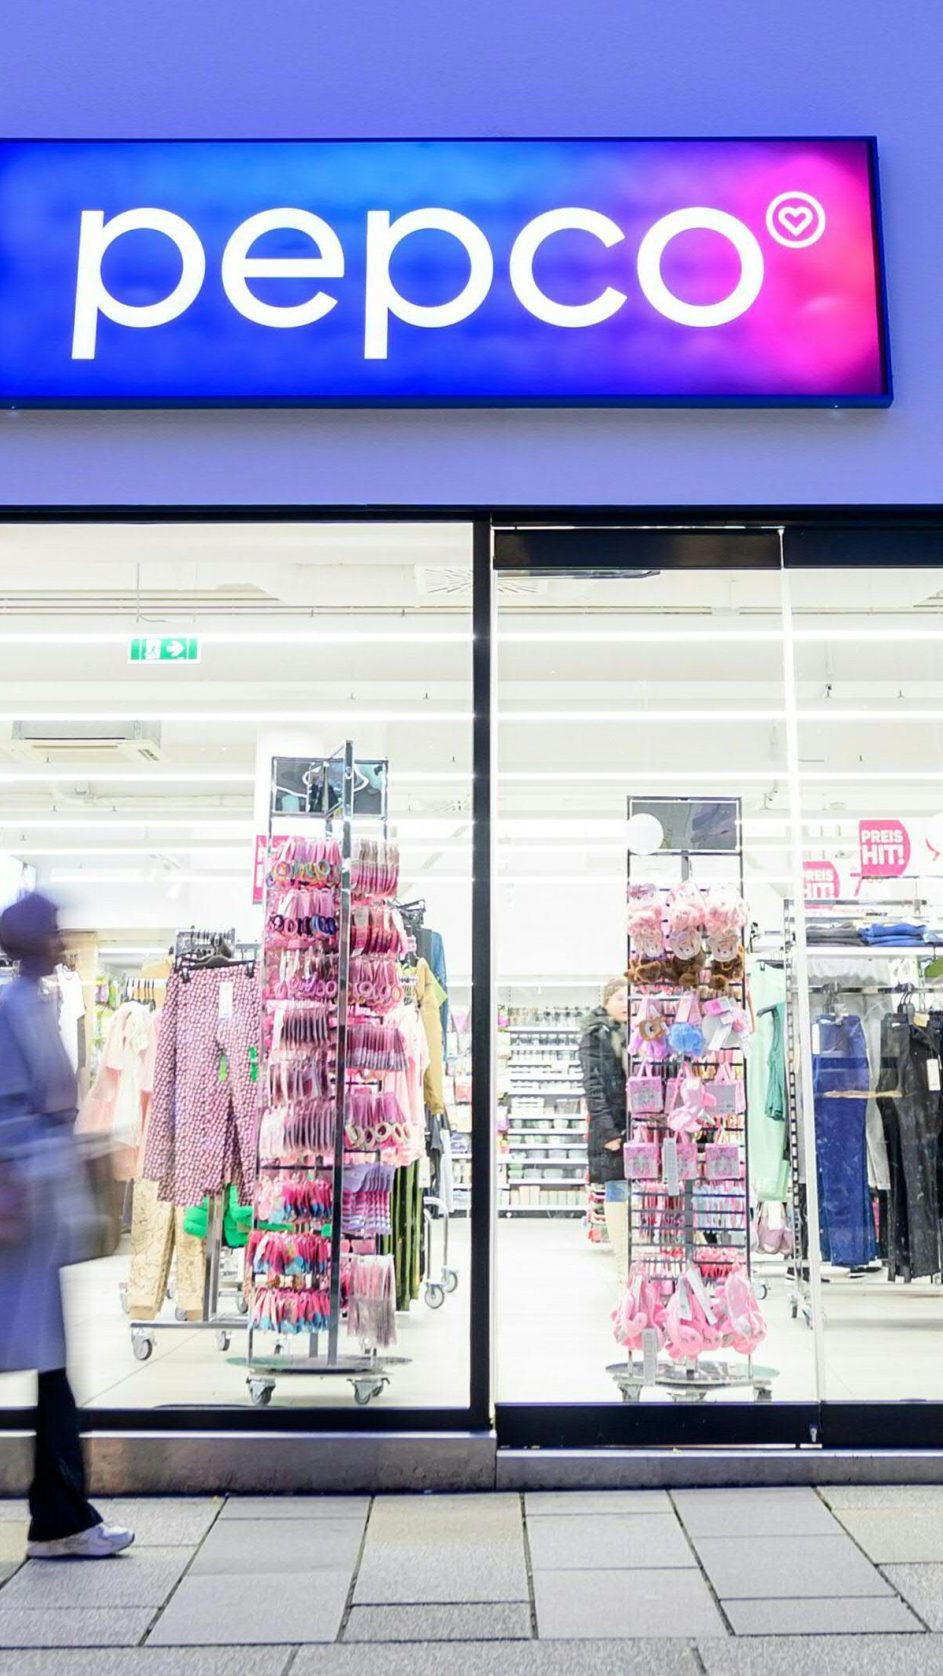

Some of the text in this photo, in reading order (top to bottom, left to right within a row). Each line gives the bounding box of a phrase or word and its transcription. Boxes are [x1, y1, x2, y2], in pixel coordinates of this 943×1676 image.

[71, 206, 765, 360] pepco
[861, 829, 904, 843] PREIS
[862, 844, 905, 865] HIT!
[804, 869, 834, 882] REIS
